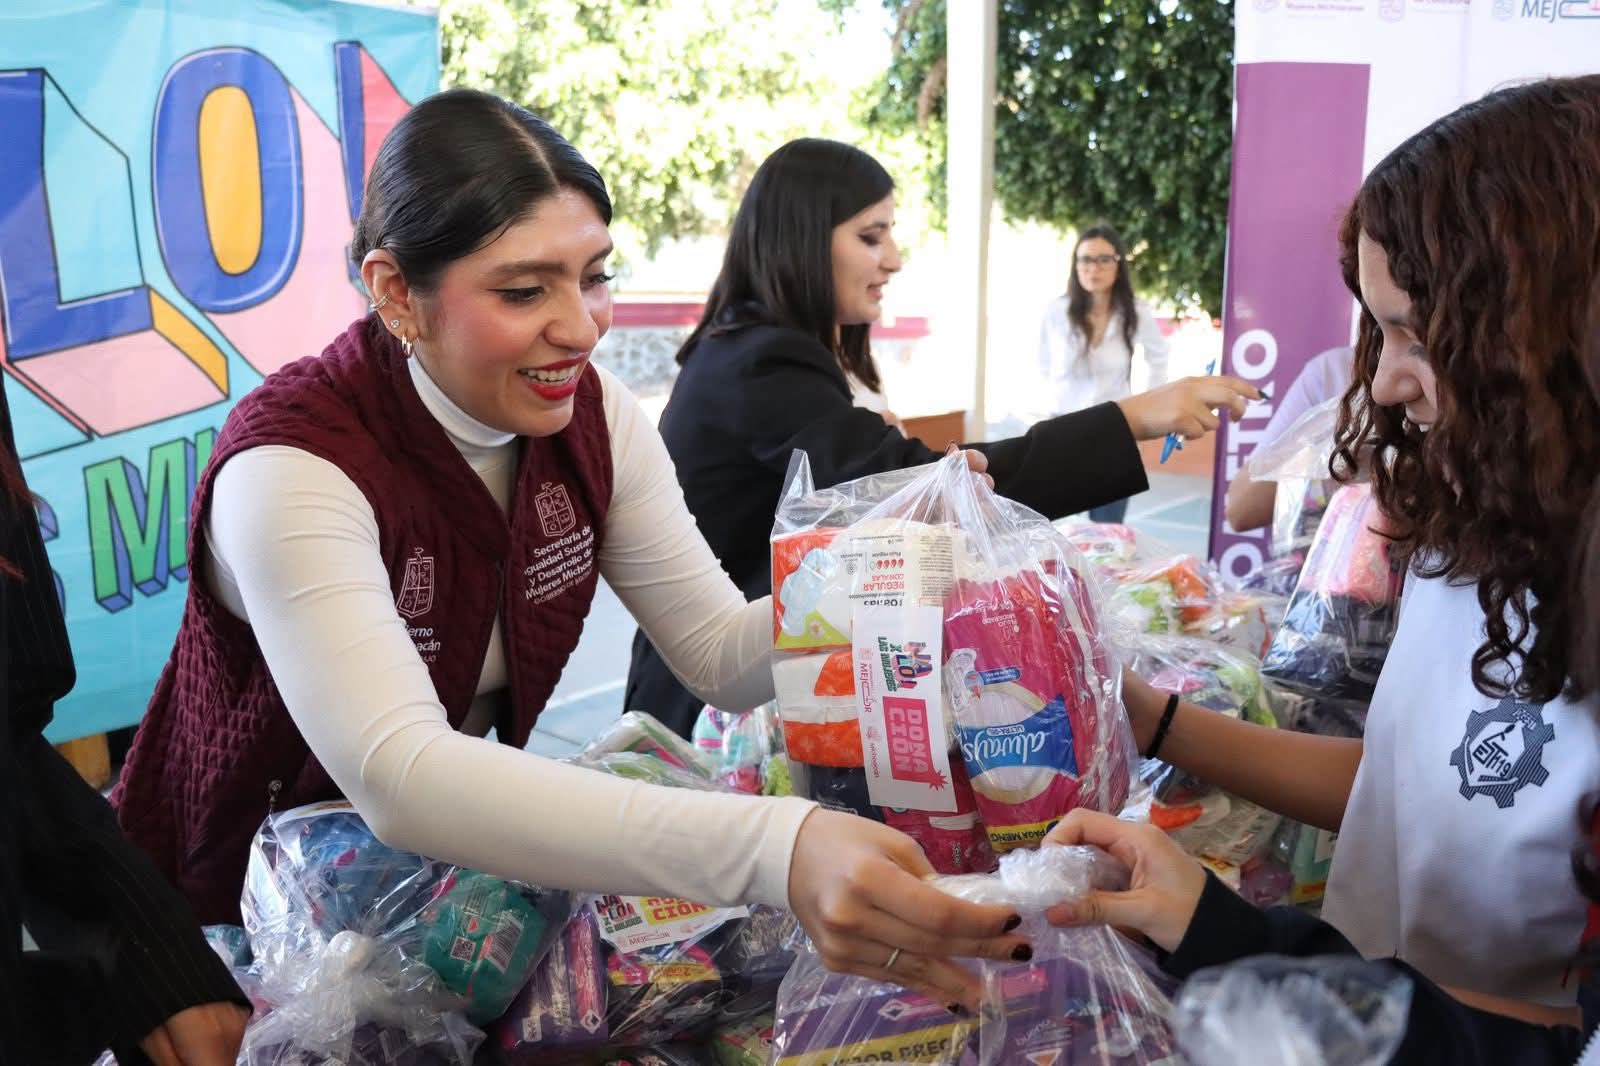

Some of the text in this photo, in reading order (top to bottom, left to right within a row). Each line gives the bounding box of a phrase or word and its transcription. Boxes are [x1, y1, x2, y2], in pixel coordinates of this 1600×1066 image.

[528, 575, 537, 587] y
[537, 554, 583, 583] Desarrollo
[863, 580, 905, 592] REGULAR
[525, 577, 562, 601] Mujeres
[889, 706, 914, 772] CIÓN
[907, 709, 929, 774] DONA
[961, 730, 1047, 765] always
